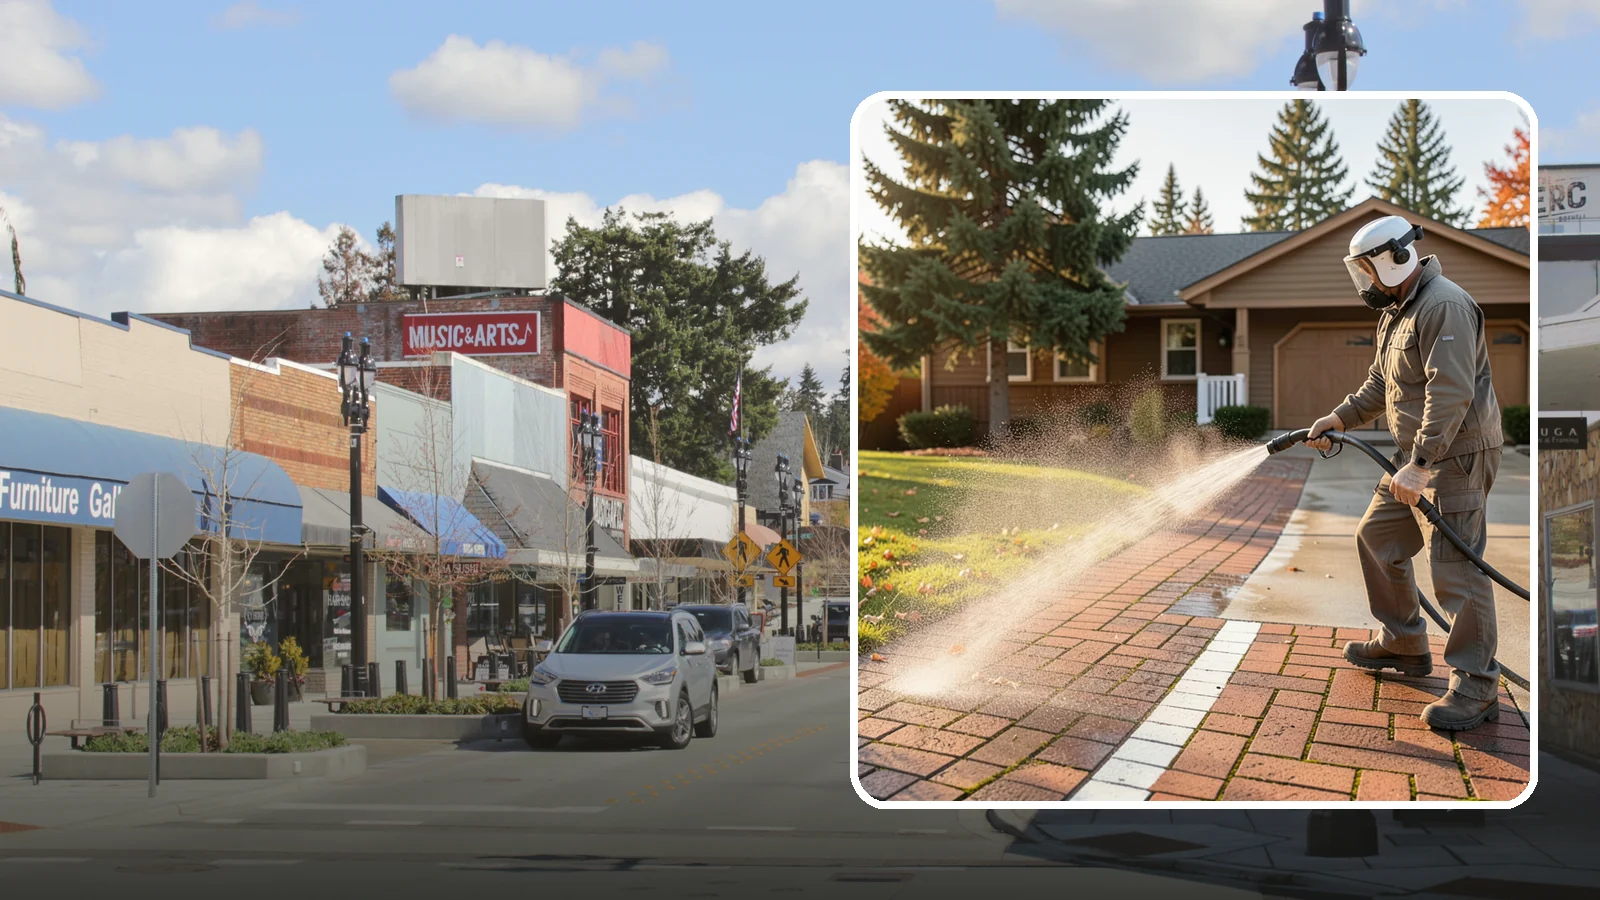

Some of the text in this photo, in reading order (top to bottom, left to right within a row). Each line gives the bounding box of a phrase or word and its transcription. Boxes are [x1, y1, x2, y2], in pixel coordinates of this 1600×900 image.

[408, 322, 520, 349] MUSIC&ARTS
[1540, 427, 1578, 437] UGA
[0, 471, 79, 516] Furniture
[453, 563, 479, 574] SUSHI
